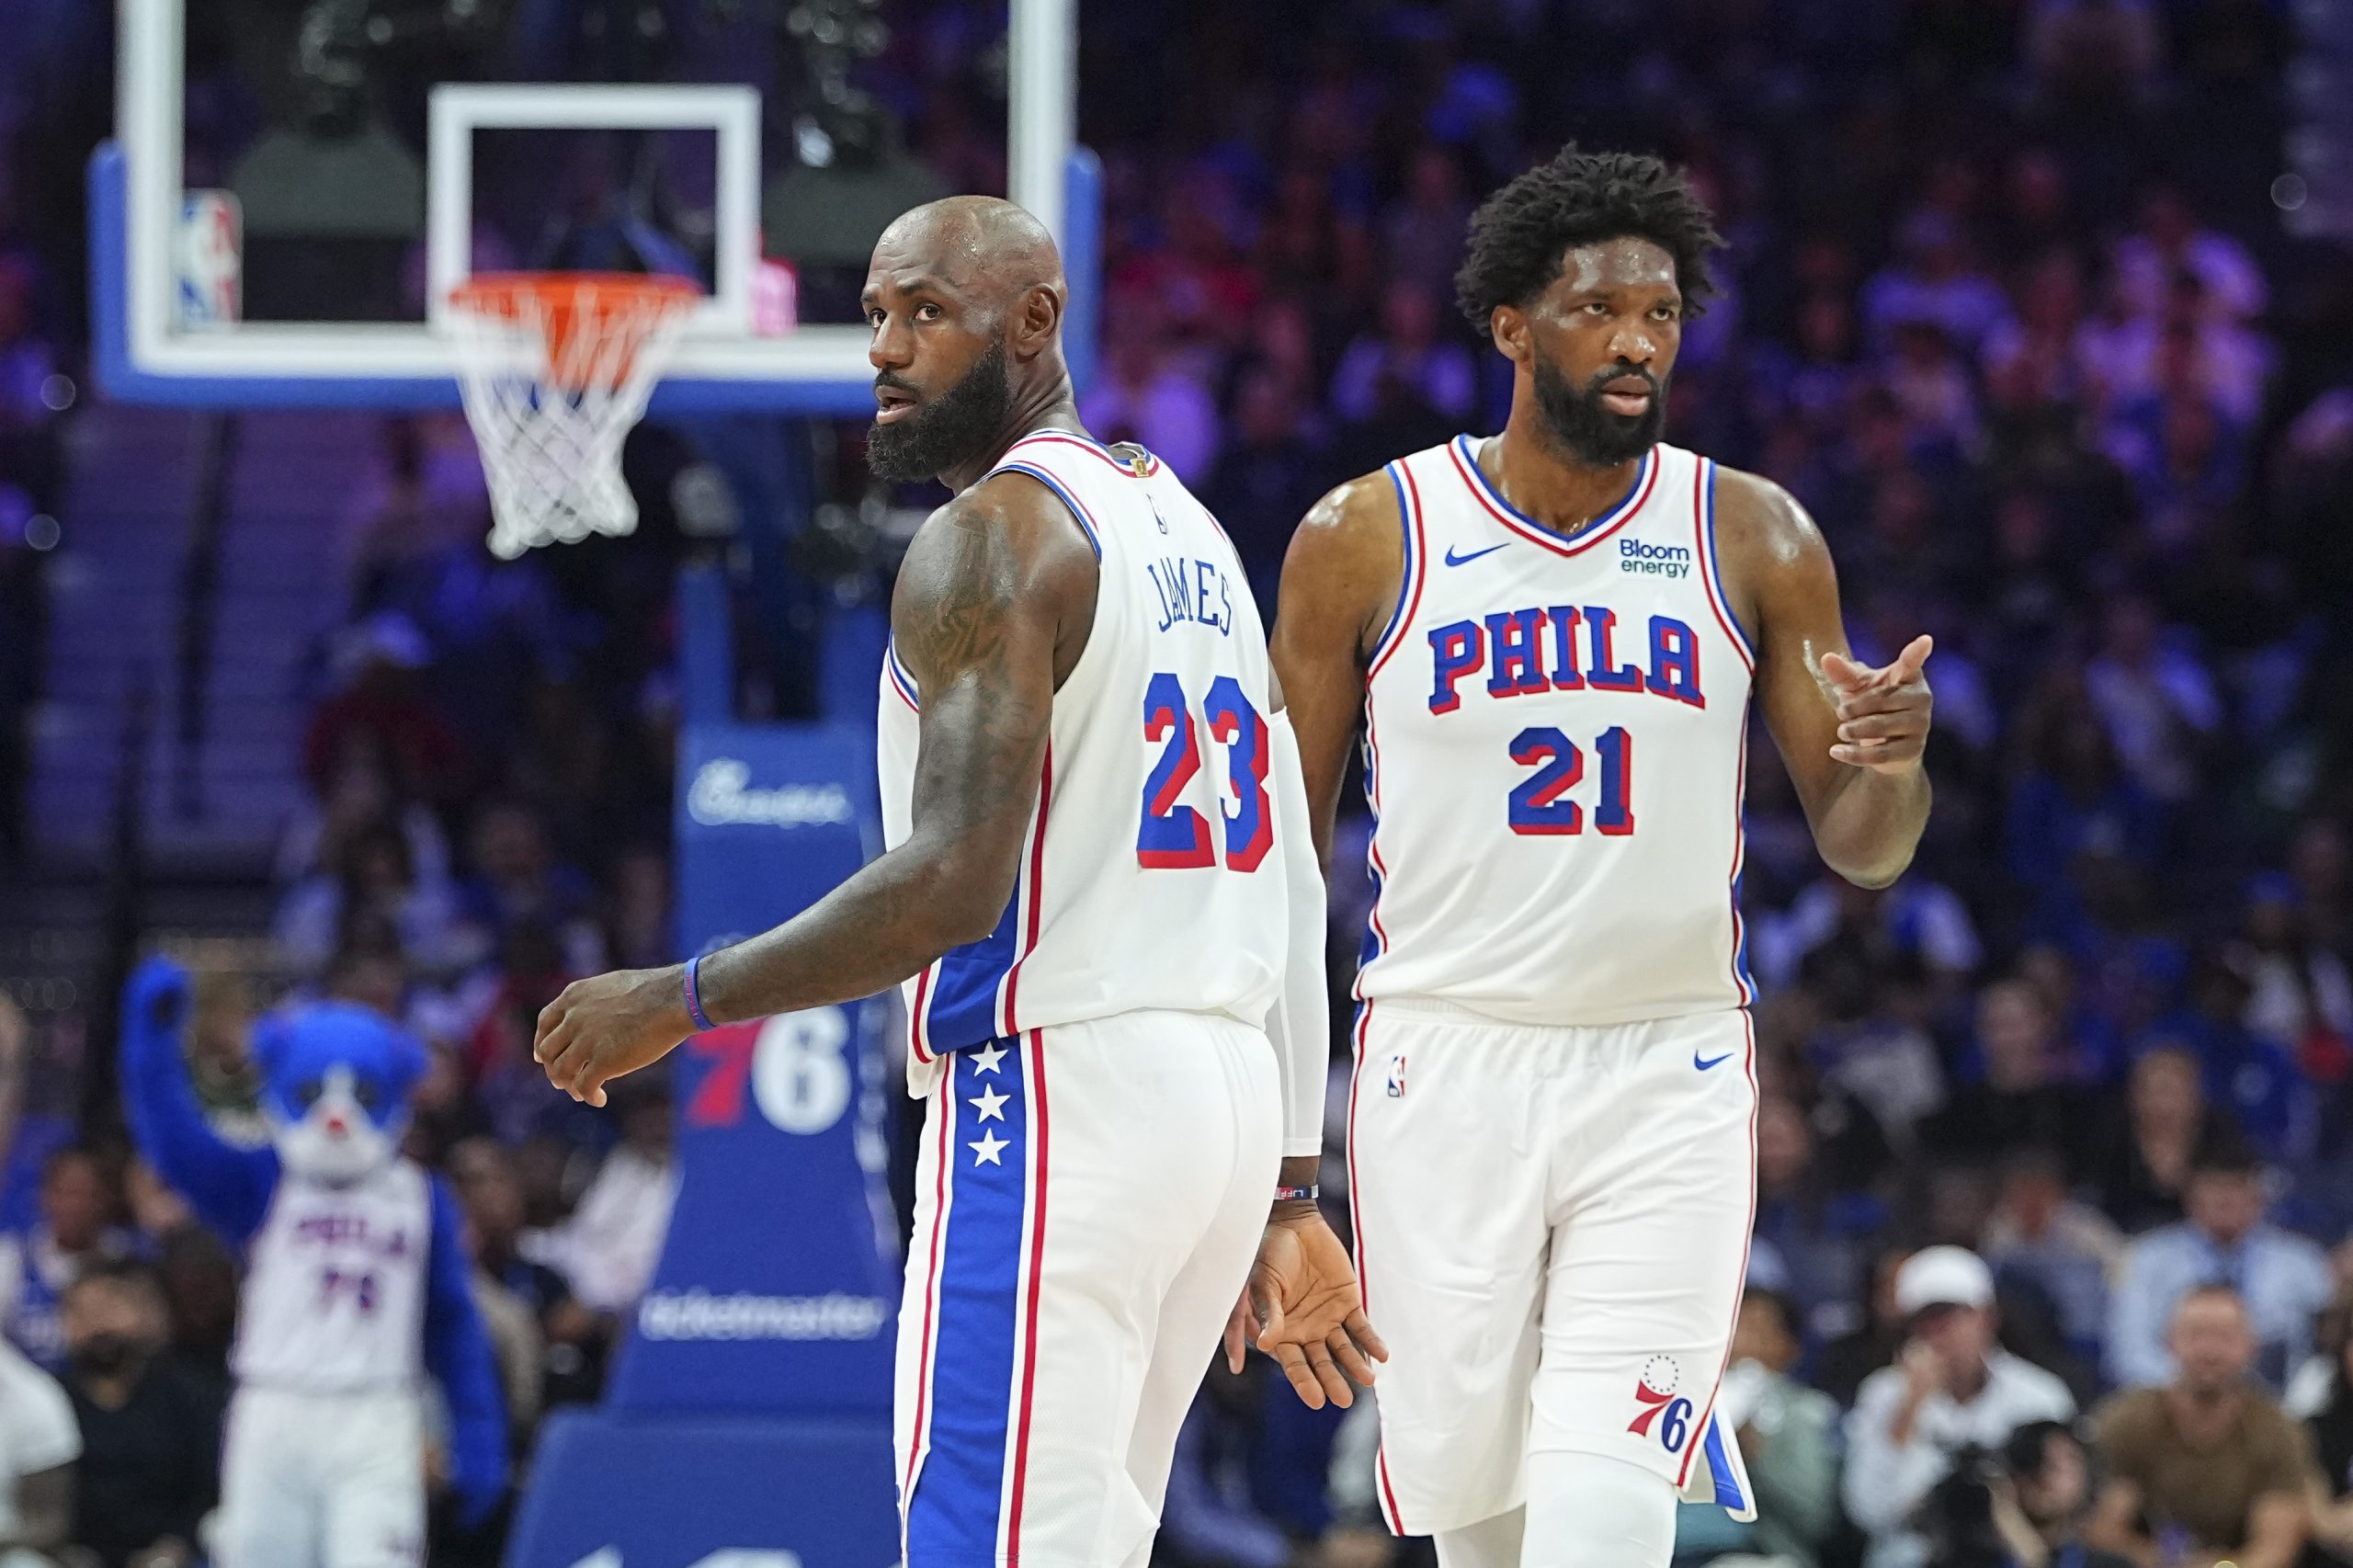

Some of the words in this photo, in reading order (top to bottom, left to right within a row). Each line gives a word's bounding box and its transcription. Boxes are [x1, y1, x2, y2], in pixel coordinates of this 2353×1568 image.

[1147, 557, 1232, 637] JAMES
[1620, 539, 1689, 561] Bloom
[1621, 560, 1689, 579] energy
[1428, 606, 1705, 716] PHILA
[1136, 673, 1274, 873] 23
[1508, 726, 1634, 835] 21
[688, 1004, 852, 1134] 76
[1627, 1379, 1692, 1453] 76
